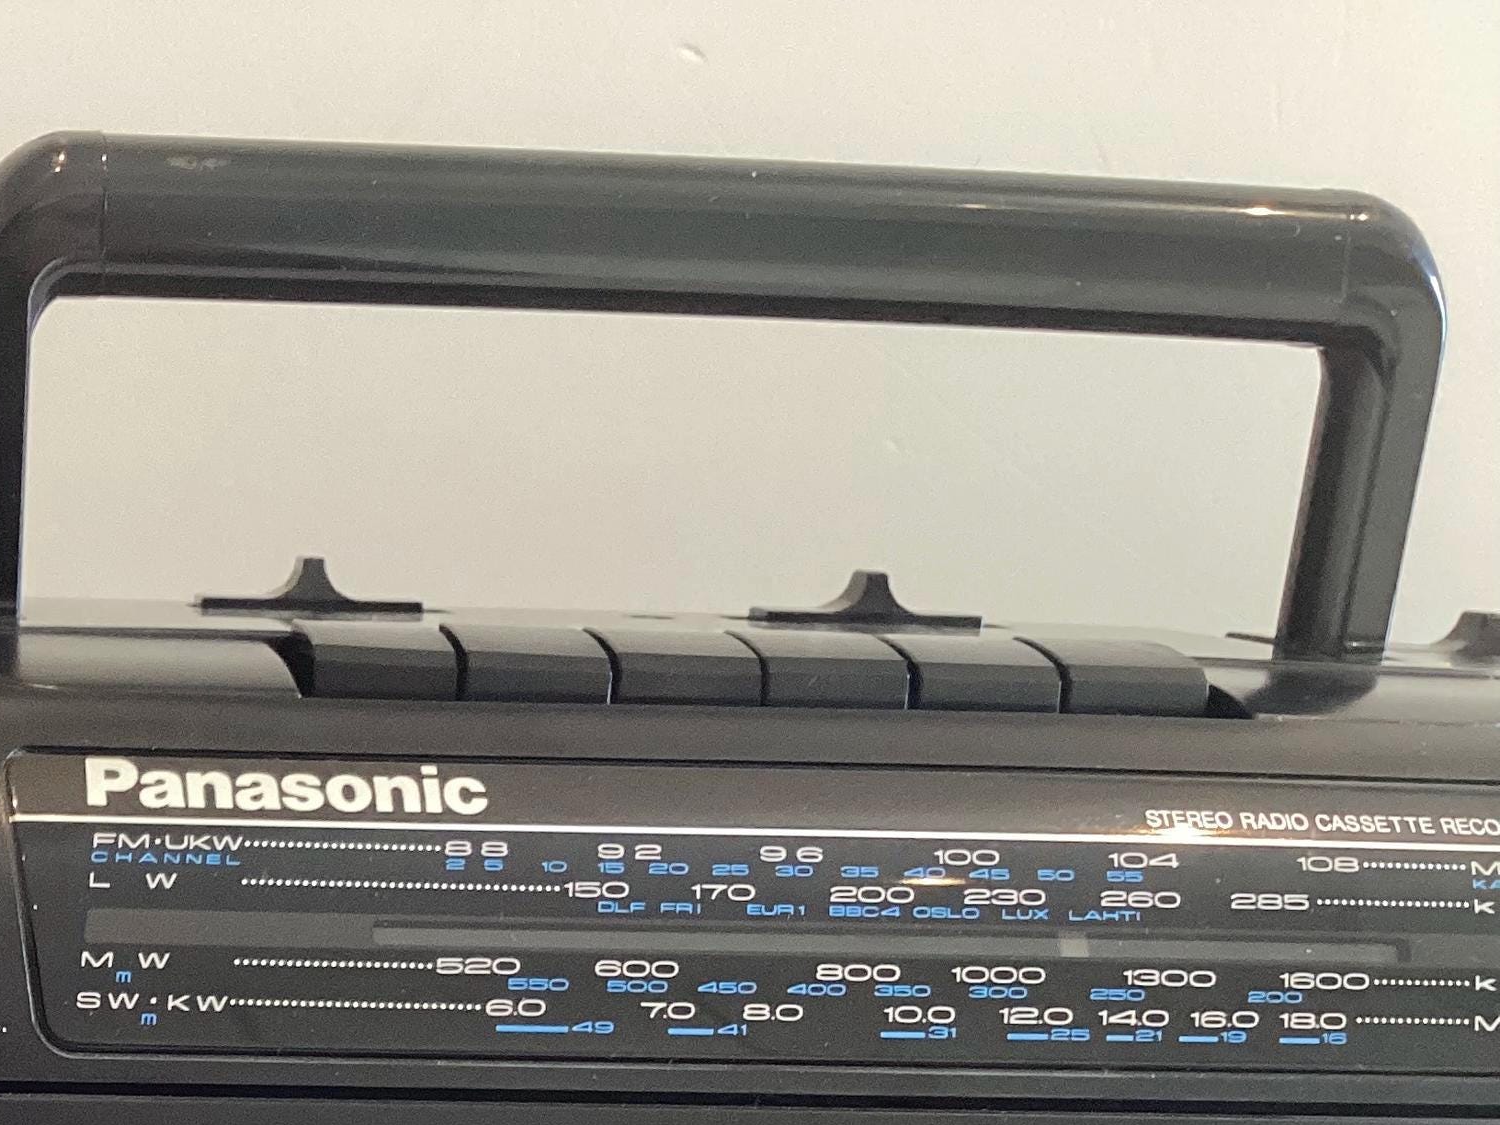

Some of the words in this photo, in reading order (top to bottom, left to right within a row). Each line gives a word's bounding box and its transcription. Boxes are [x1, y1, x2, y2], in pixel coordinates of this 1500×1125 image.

[85, 757, 489, 815] Panasonic
[1145, 809, 1233, 829] STEREO
[1240, 812, 1309, 831] RADIO
[1315, 814, 1435, 835] CASSETTE
[91, 851, 241, 865] CHANNEL
[541, 861, 567, 873] 10
[598, 862, 625, 874] 15
[649, 862, 689, 875] 20
[712, 864, 750, 876] 25
[775, 865, 814, 877] 30
[841, 866, 879, 878] 35
[904, 867, 946, 878] 40
[969, 869, 1010, 880] 45
[1037, 869, 1075, 881] 50
[1107, 871, 1144, 882] 55
[934, 849, 1000, 866] 100
[1108, 853, 1179, 868] 104
[1296, 857, 1360, 873] 108
[564, 881, 630, 898] 150
[691, 884, 756, 902] 170
[829, 886, 915, 903] 200
[963, 889, 1047, 906] 230
[1100, 891, 1181, 909] 260
[1231, 894, 1310, 910] 285
[598, 901, 646, 914] DLF
[829, 906, 901, 918] BBC4
[912, 907, 980, 920] OSLO
[1001, 908, 1049, 921] LUX
[1068, 910, 1141, 922] LAHTI
[115, 971, 132, 983] m
[507, 978, 570, 991] 550
[606, 980, 669, 993] 500
[697, 981, 758, 994] 450
[786, 983, 847, 996] 400
[873, 984, 932, 997] 350
[968, 986, 1029, 999] 300
[1090, 988, 1146, 1001] 250
[1247, 991, 1303, 1004] 200
[436, 957, 521, 975] 520
[595, 960, 680, 978] 600
[815, 963, 901, 982] 800
[951, 966, 1047, 984] 1000
[1123, 969, 1217, 988] 1300
[1279, 972, 1370, 990] 1600
[140, 1012, 157, 1025] m
[572, 1021, 615, 1034] 49
[717, 1023, 749, 1037] 41
[927, 1027, 957, 1039] 31
[1050, 1028, 1091, 1041] 25
[1135, 1029, 1163, 1042] 21
[1220, 1031, 1248, 1044] 19
[485, 999, 547, 1017] 6.0
[640, 1002, 696, 1020] 7.0
[742, 1003, 804, 1021] 8.0
[883, 1005, 957, 1024] 10.0
[998, 1006, 1075, 1026] 12.0
[1098, 1009, 1171, 1028] 14.0
[1189, 1010, 1261, 1029] 16.0
[1278, 1012, 1348, 1030] 18.0
